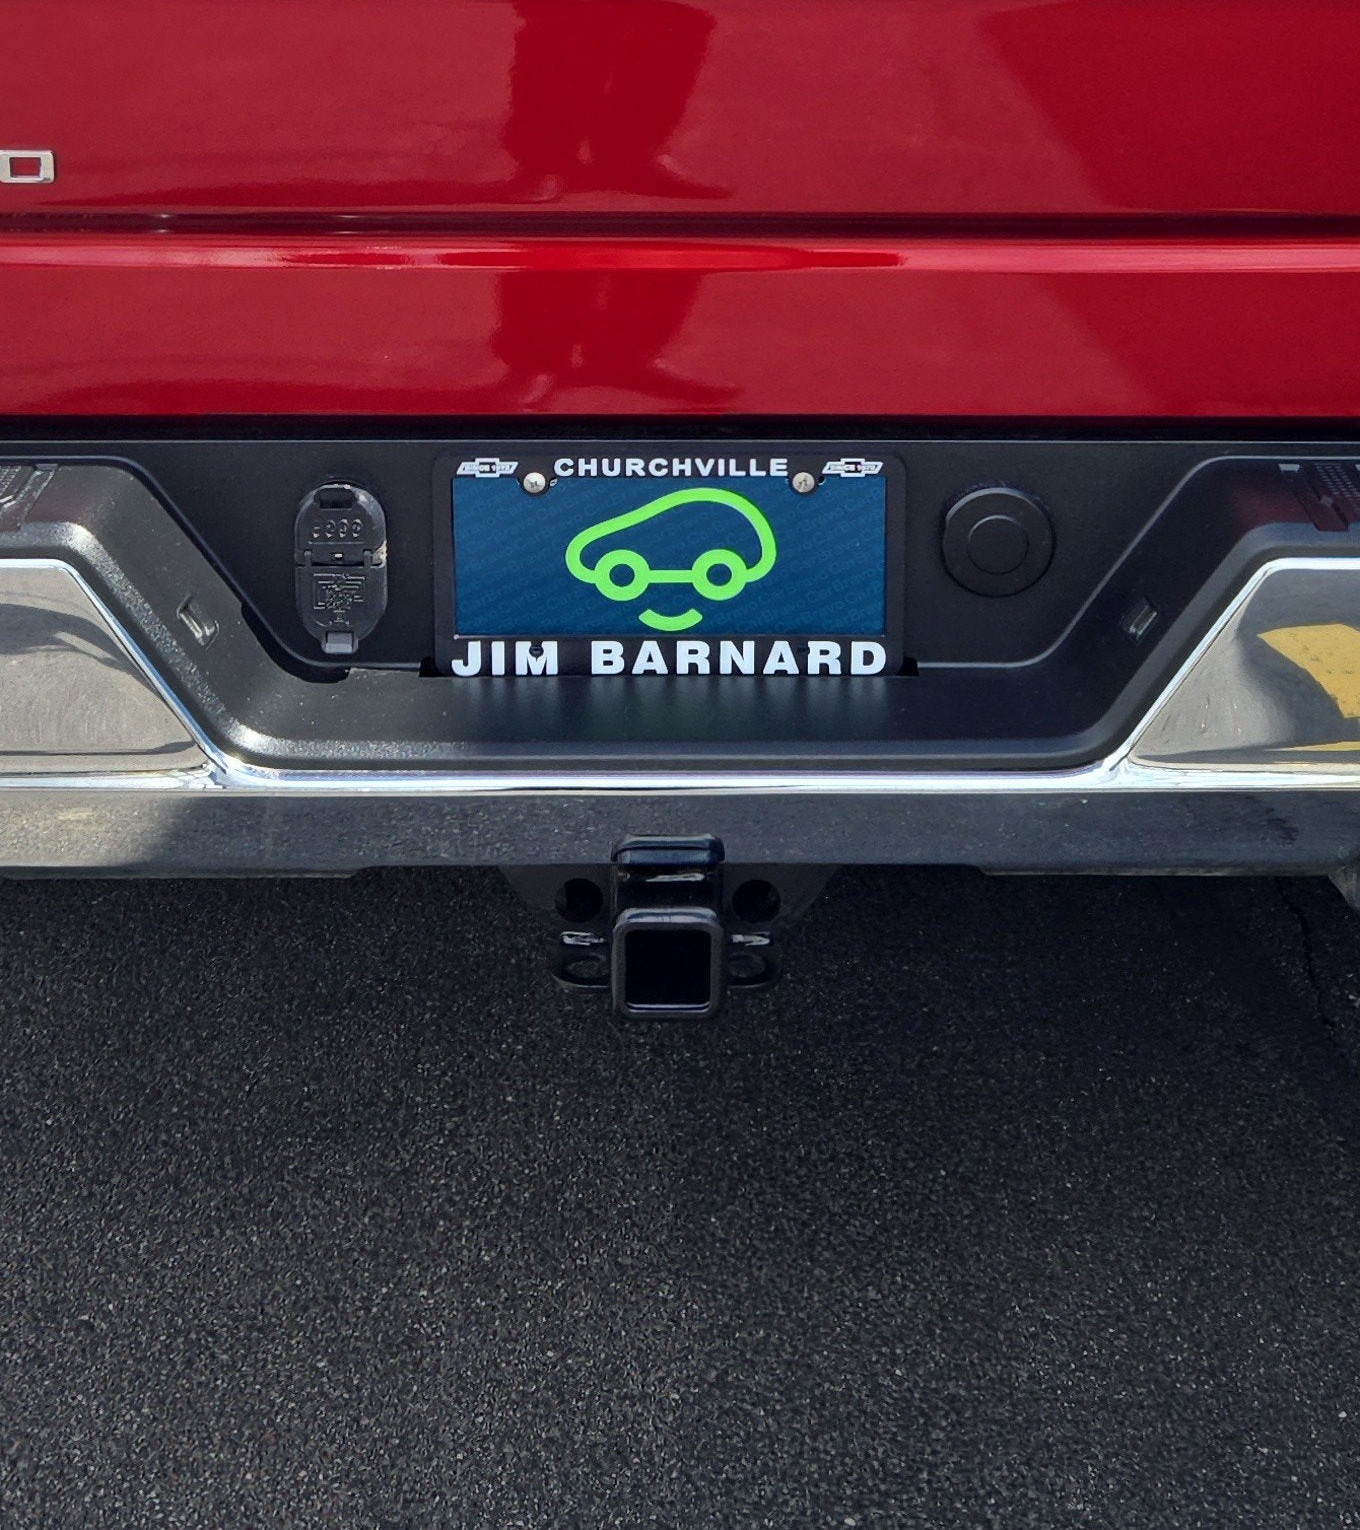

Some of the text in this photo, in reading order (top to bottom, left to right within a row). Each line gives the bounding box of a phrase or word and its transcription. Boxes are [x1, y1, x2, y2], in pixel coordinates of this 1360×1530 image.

[553, 457, 789, 478] CHURCHVILLE
[451, 640, 887, 677] JIM BARNARD
